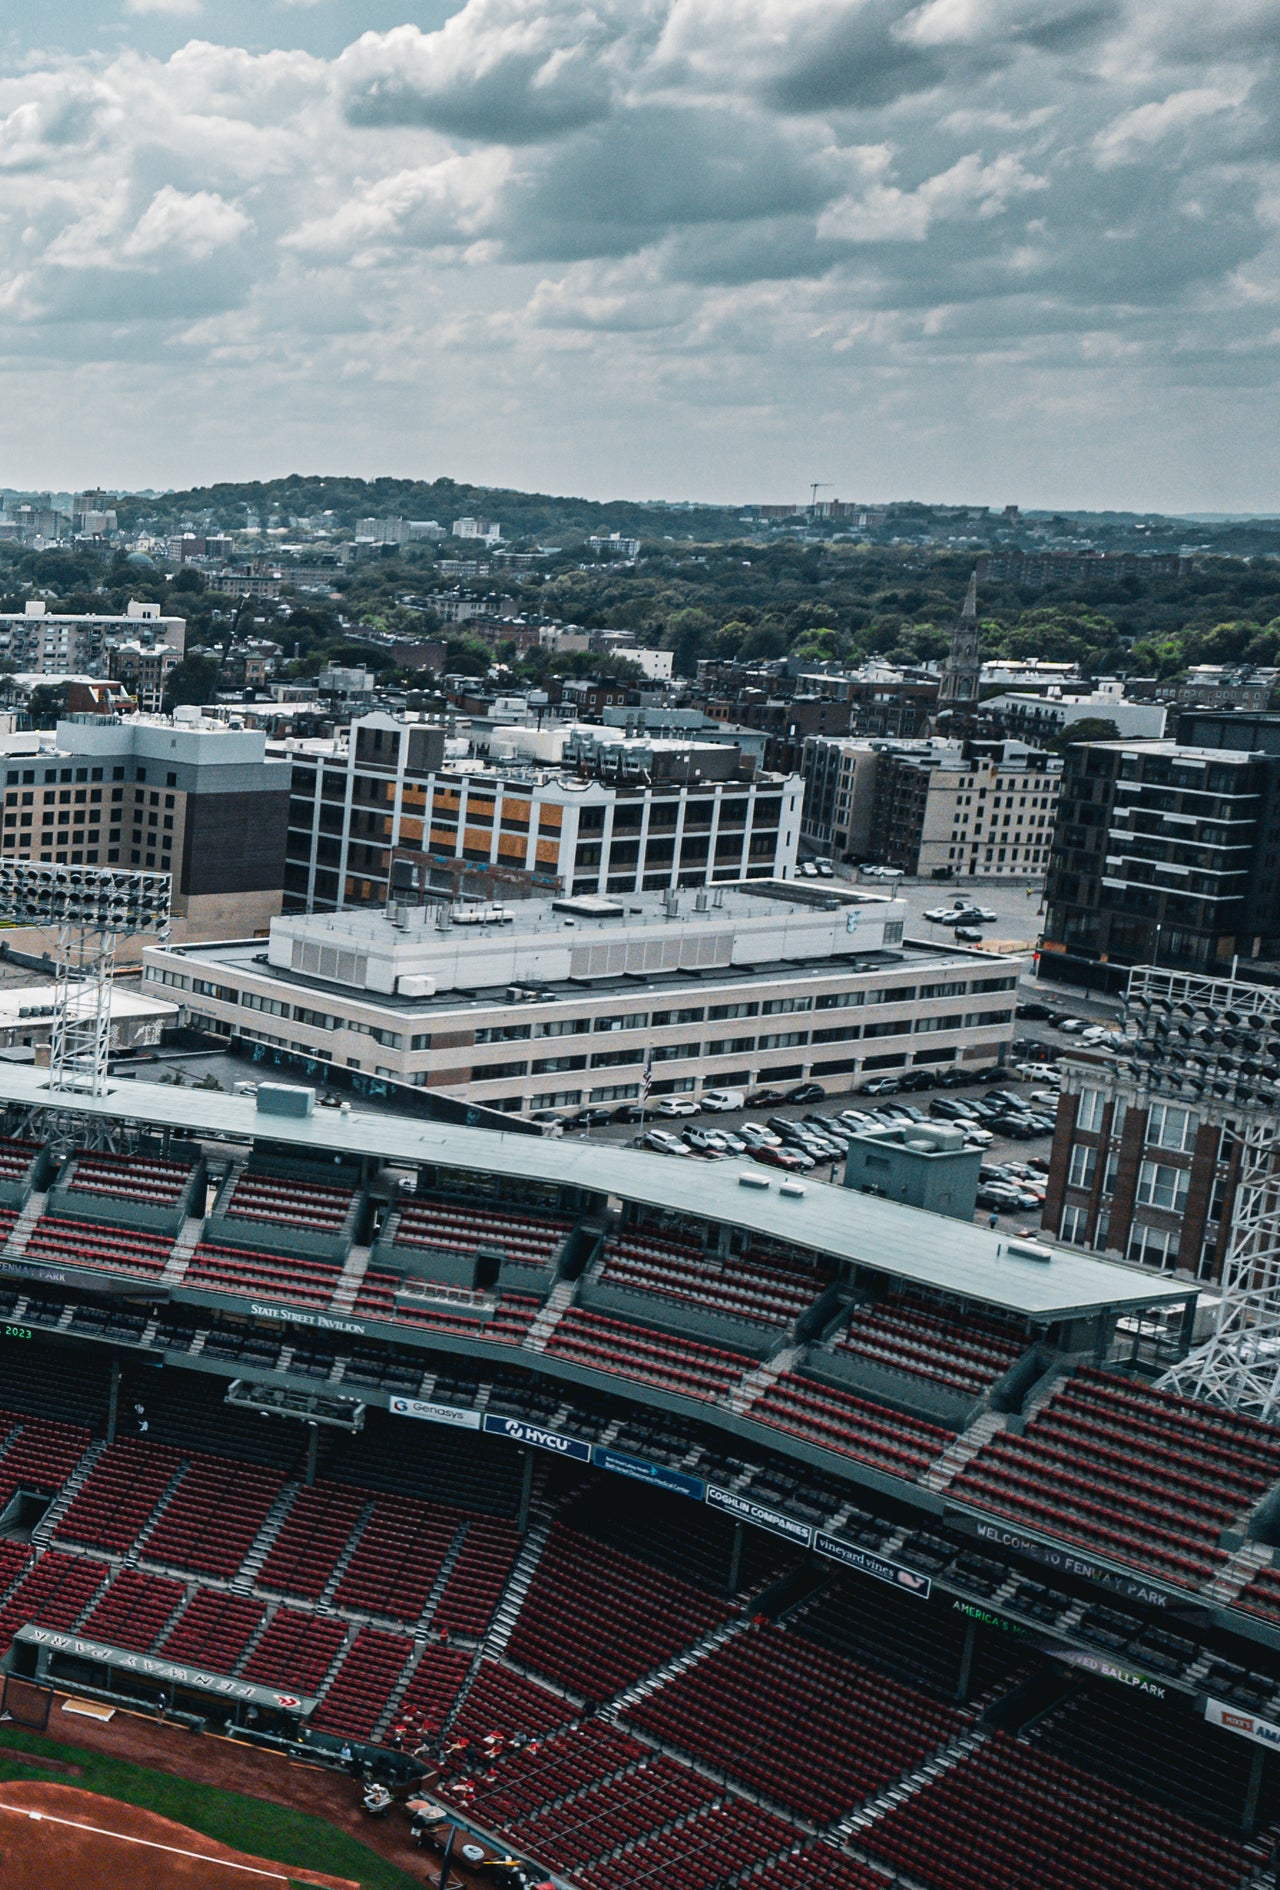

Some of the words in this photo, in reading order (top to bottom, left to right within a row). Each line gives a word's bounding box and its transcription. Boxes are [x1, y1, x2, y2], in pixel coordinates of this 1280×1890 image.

[5, 1326, 32, 1339] 2023
[251, 1304, 280, 1318] STATE
[280, 1310, 314, 1324] STREET
[317, 1316, 365, 1334] PAVILION
[413, 1403, 464, 1420] Genasys
[525, 1428, 568, 1451] HYCU
[709, 1489, 749, 1513] COGHLIN
[750, 1507, 808, 1537] COMPANIES
[820, 1539, 864, 1564] vineyard
[866, 1558, 894, 1577] vines
[977, 1523, 1040, 1558] WELCOME
[1126, 1583, 1168, 1608] PARK
[952, 1600, 1009, 1631] AMERICA'S
[29, 1629, 113, 1659] PARK
[119, 1655, 257, 1698] FENWAY
[1101, 1663, 1166, 1699] BALLPARK
